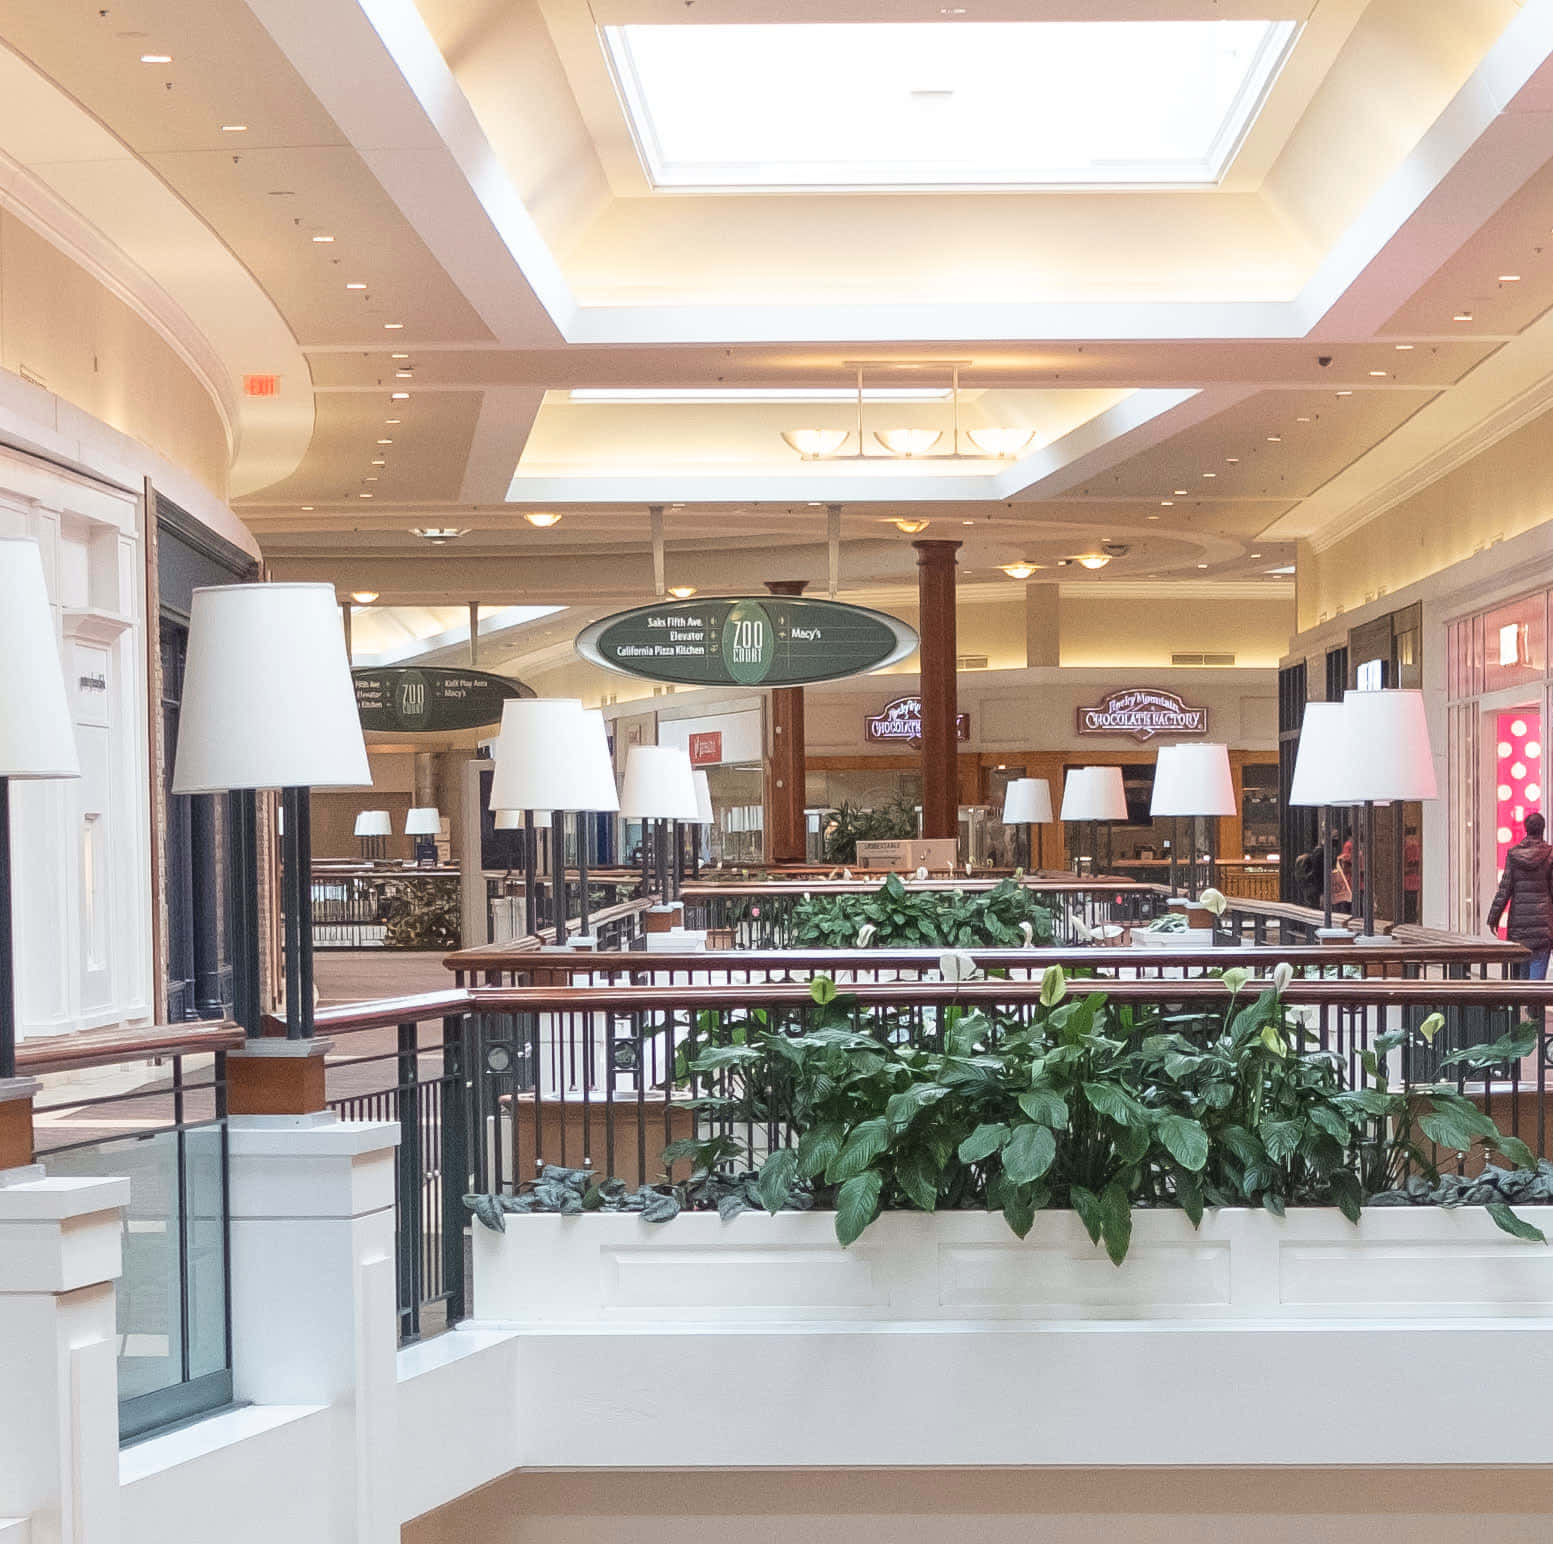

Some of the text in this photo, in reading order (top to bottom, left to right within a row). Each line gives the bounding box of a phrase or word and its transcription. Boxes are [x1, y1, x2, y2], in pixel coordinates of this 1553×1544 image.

[647, 616, 666, 628] Saks
[667, 616, 686, 628] Fifth
[669, 630, 705, 642] Elevator
[733, 620, 763, 649] ZOO
[791, 627, 822, 641] Macy's
[616, 644, 705, 657] California Pizza Kitchen
[733, 648, 762, 664] COURT
[1085, 711, 1200, 729] CHOCOLATE FACTORY
